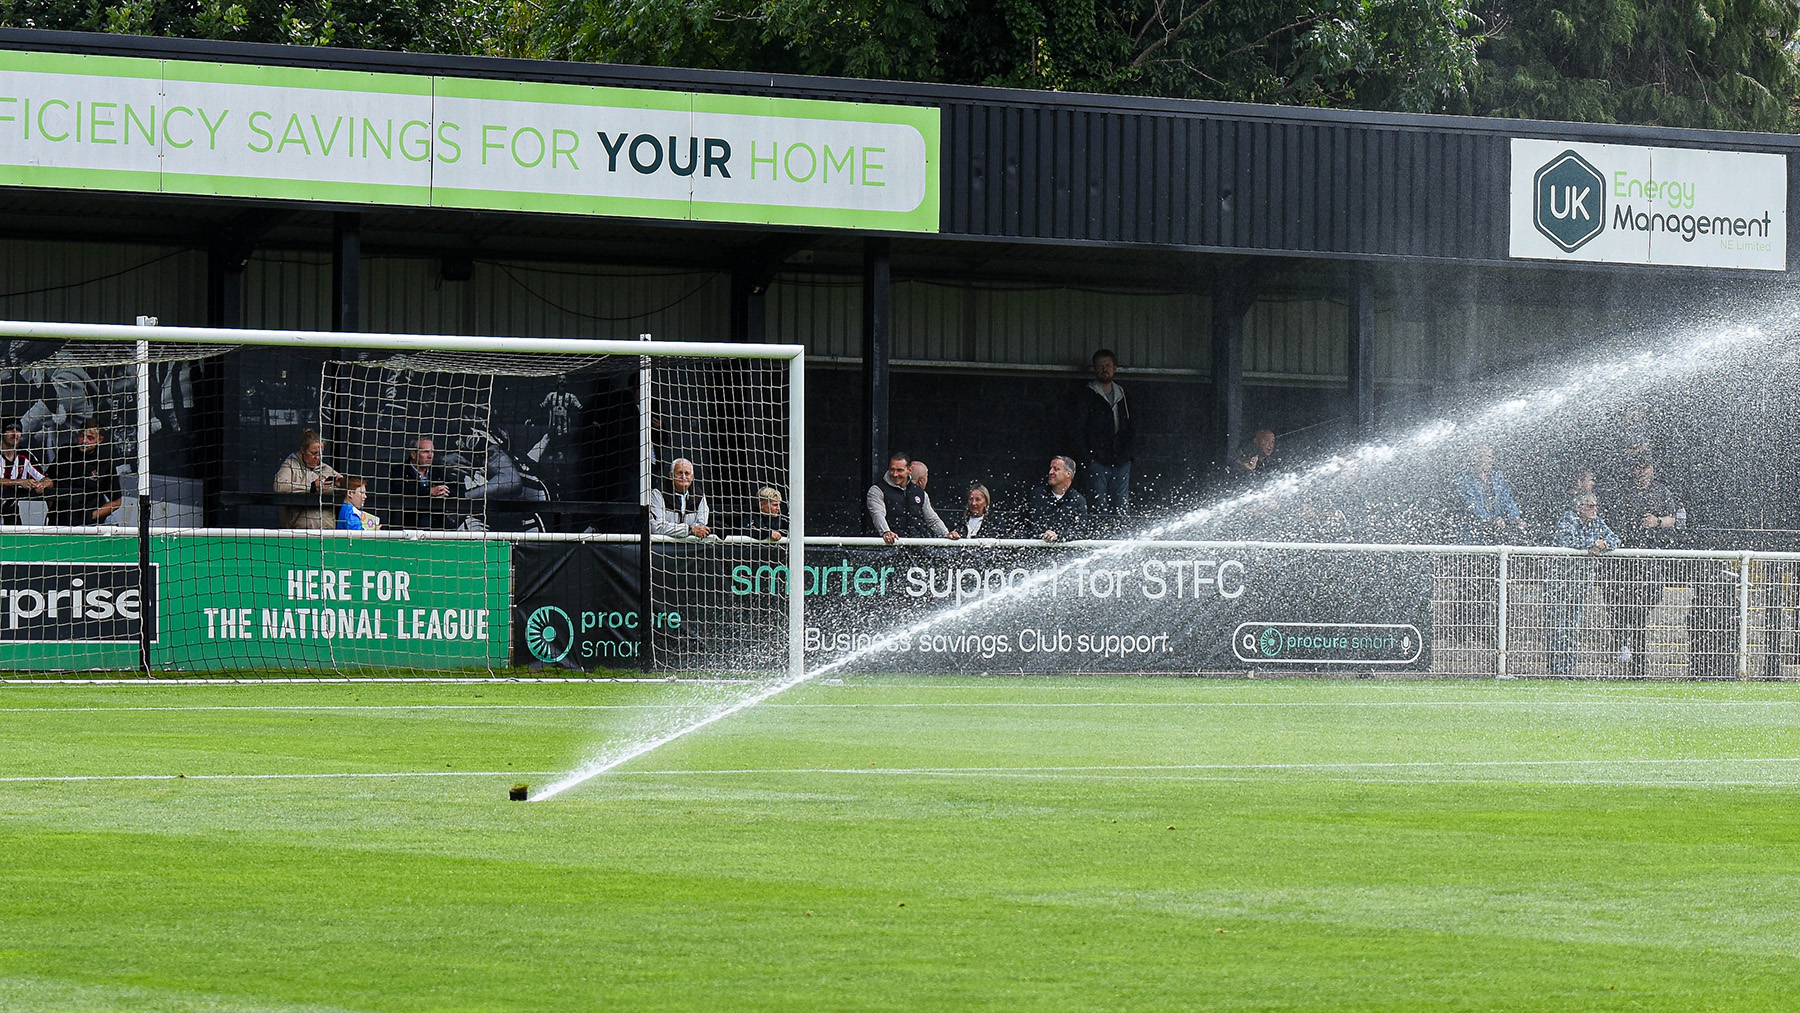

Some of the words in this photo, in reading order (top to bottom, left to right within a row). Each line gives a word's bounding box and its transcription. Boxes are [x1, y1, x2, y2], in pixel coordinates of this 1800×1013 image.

[247, 111, 462, 164] SAVINGS
[481, 124, 580, 171] FOR
[596, 130, 732, 179] YOUR
[750, 140, 887, 188] HOME
[1550, 184, 1591, 221] UK
[1613, 171, 1696, 210] Energy
[1613, 203, 1772, 243] Management
[1720, 239, 1734, 250] NE
[1736, 239, 1772, 252] Limited
[287, 569, 352, 601] HERE
[362, 569, 412, 601] FOR
[730, 558, 895, 597] smarter
[1075, 558, 1131, 599] for
[1142, 558, 1246, 600] STFC
[0, 577, 140, 630] prise
[203, 607, 252, 639] THE
[261, 607, 388, 640] NATIONAL
[398, 608, 490, 640] LEAGUE
[581, 610, 682, 634] procre
[581, 640, 643, 658] smar
[918, 630, 1013, 659] savings.
[1018, 628, 1073, 653] Club
[1077, 630, 1174, 659] support.
[1287, 635, 1348, 651] procure
[1351, 635, 1396, 650] smart
